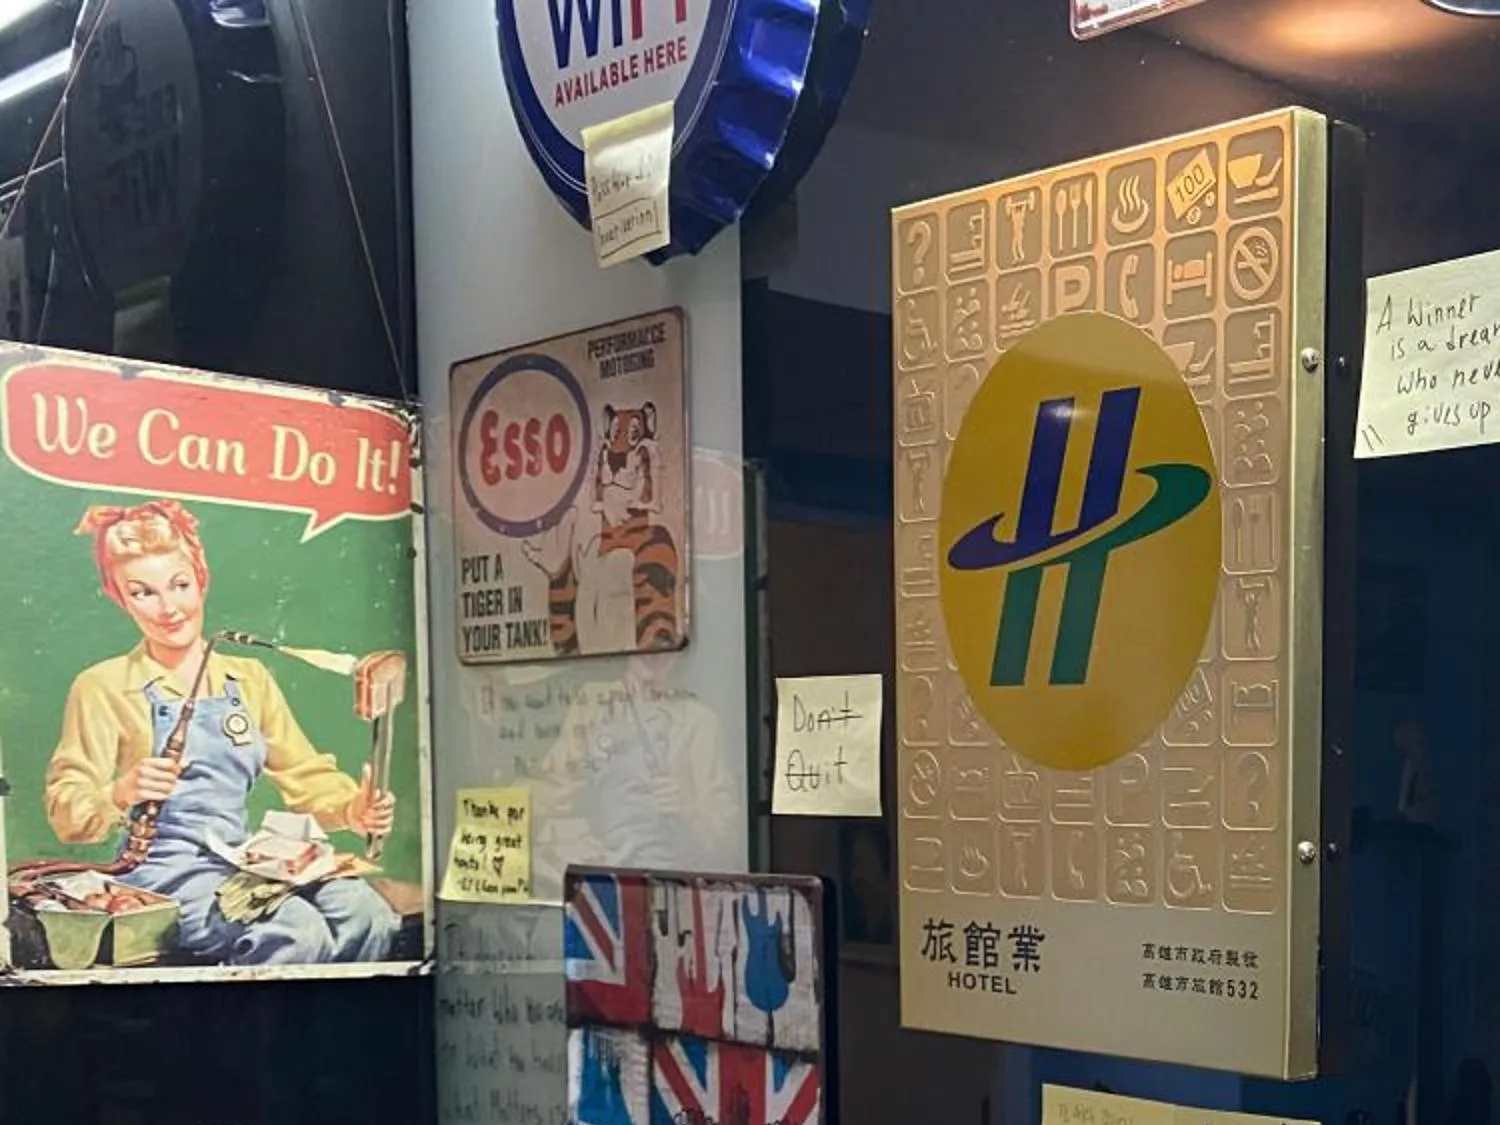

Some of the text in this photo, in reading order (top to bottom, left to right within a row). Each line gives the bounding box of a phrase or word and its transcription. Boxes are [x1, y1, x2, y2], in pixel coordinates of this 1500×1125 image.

[555, 36, 688, 108] AVAILABLE HERE
[1174, 162, 1206, 203] 100
[1375, 294, 1392, 335] A
[1391, 337, 1405, 361] is
[1417, 339, 1434, 351] a
[1407, 401, 1461, 436] gives
[32, 392, 401, 495] We Can Do It!
[460, 554, 504, 585] PUT A
[461, 586, 523, 619] TIGER IN
[461, 620, 548, 653] YOUR TANK!
[920, 917, 1045, 974] 旅館業
[948, 971, 1017, 996] HOTEL
